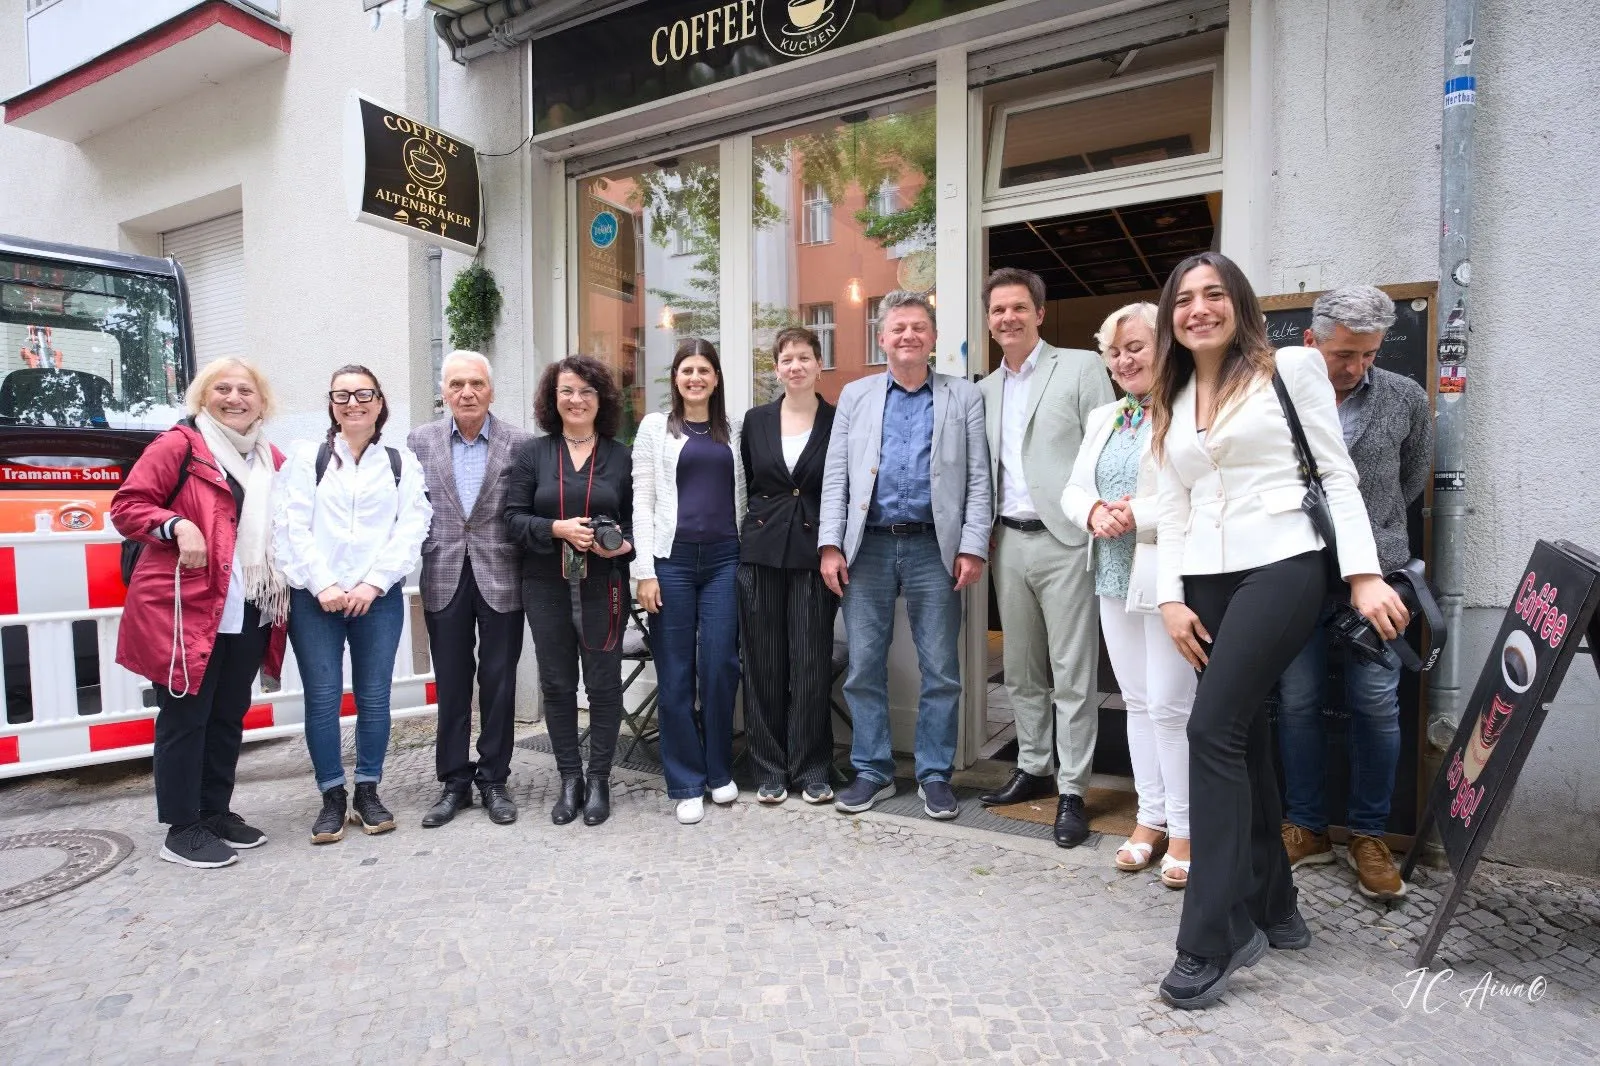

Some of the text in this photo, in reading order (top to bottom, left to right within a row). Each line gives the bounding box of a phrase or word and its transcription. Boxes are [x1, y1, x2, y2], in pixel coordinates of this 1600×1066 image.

[651, 0, 757, 66] COFFEE
[780, 25, 837, 52] KUCHEN
[383, 115, 460, 158] COFFEE
[375, 188, 472, 228] ALTENBRAKER
[405, 183, 448, 207] CAKE
[1514, 571, 1568, 648] Coffee
[1450, 777, 1485, 828] go!
